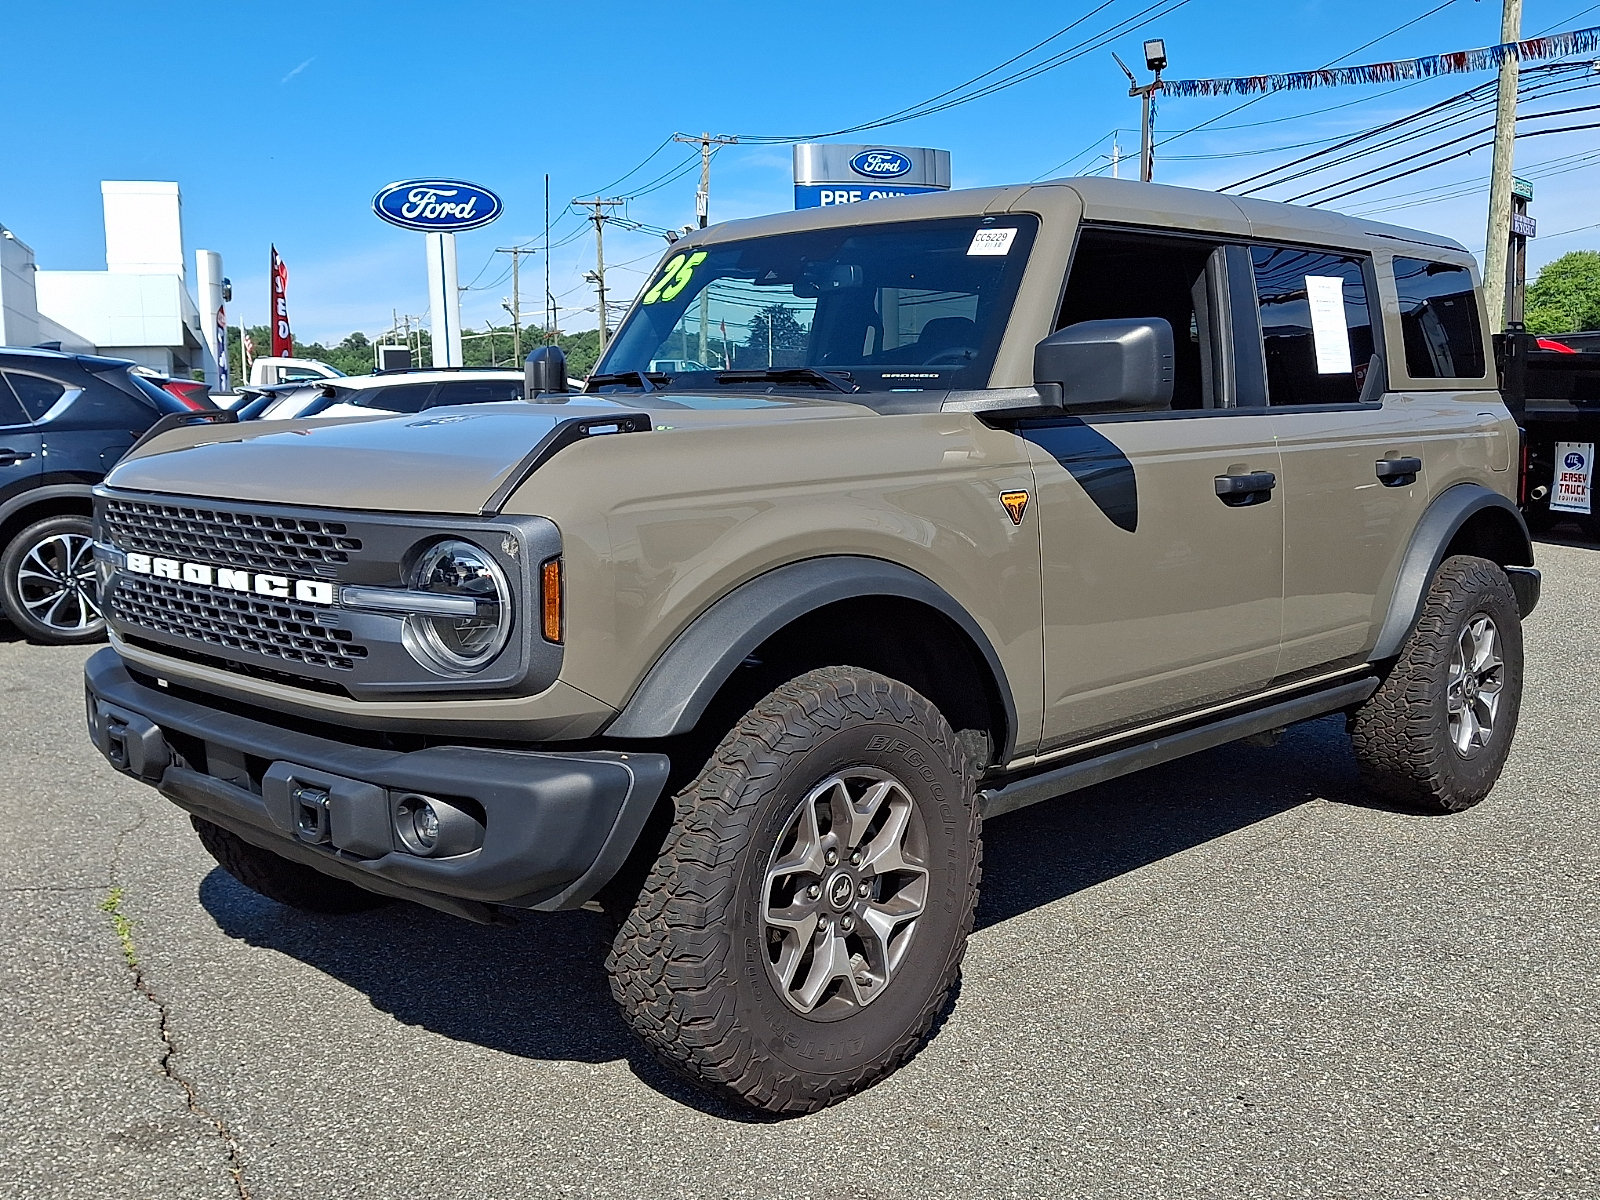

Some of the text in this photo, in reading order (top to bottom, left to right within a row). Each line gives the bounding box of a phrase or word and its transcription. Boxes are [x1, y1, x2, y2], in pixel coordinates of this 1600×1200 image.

[863, 154, 901, 172] Ford
[402, 188, 477, 218] Ford
[975, 232, 1008, 241] CC5229
[642, 252, 708, 305] 25
[1559, 472, 1587, 483] JERSEY
[1559, 484, 1586, 495] TRUCK
[126, 552, 333, 604] BRONCO
[865, 734, 960, 914] BFGoodrich
